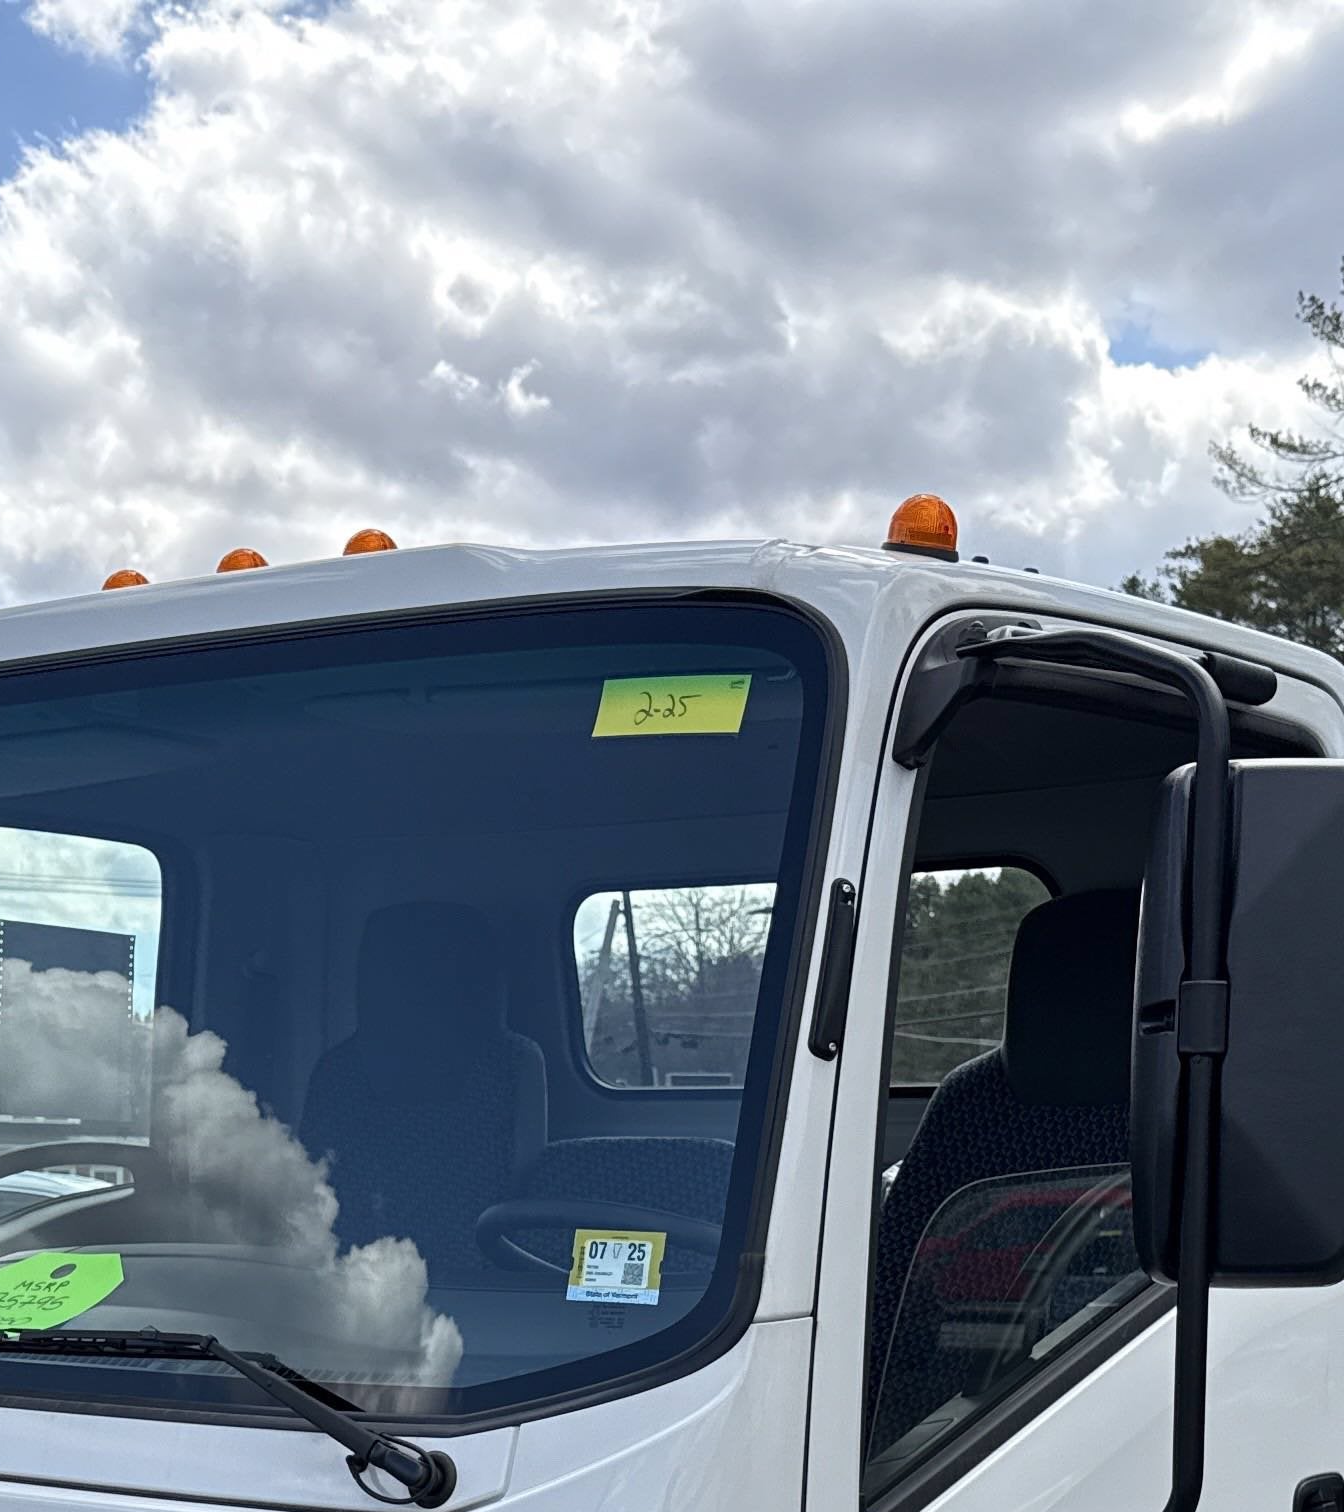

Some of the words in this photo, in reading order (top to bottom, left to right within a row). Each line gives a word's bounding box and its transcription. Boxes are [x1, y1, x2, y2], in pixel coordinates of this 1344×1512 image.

[588, 1241, 607, 1259] 07
[627, 1243, 646, 1261] 25
[15, 1279, 71, 1294] MSRP
